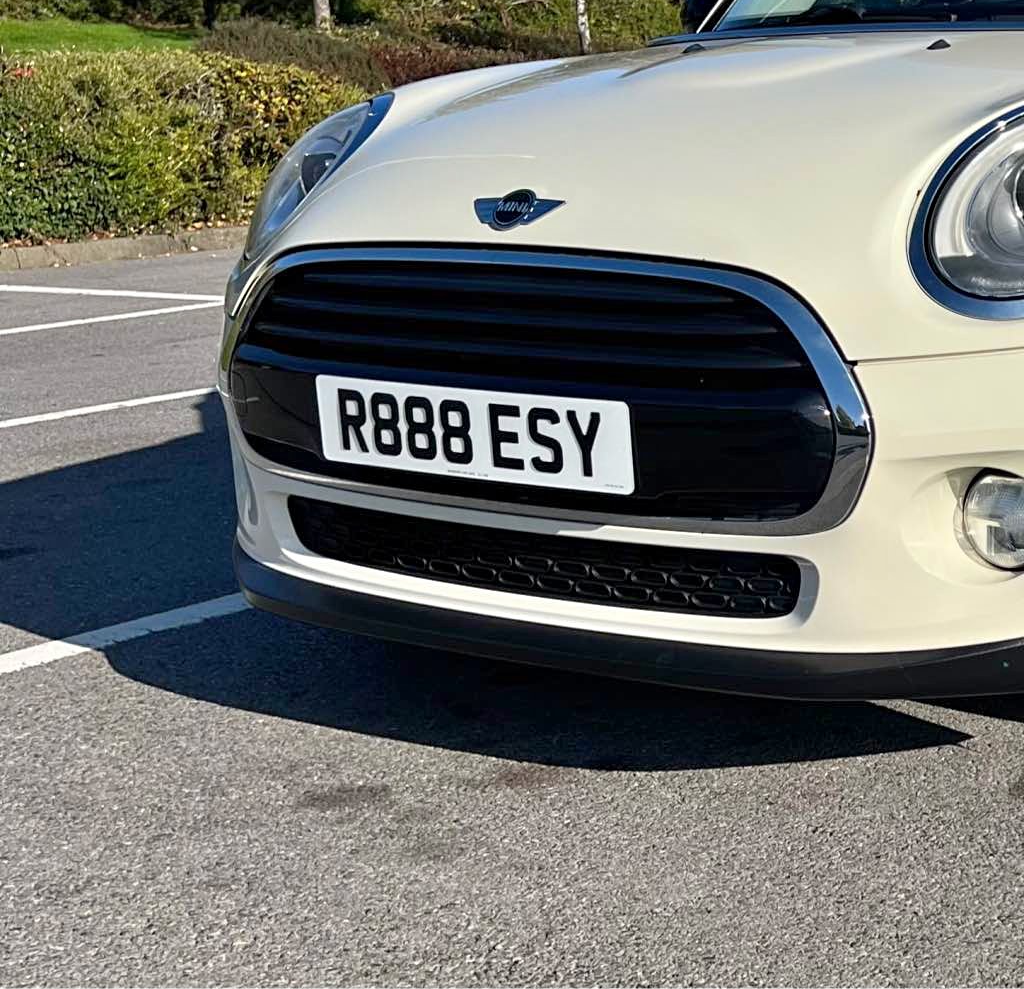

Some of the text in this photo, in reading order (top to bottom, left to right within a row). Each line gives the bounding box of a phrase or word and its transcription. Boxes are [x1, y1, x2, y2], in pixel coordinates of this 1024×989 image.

[497, 200, 529, 212] MINI
[337, 388, 601, 477] R888 ESY
